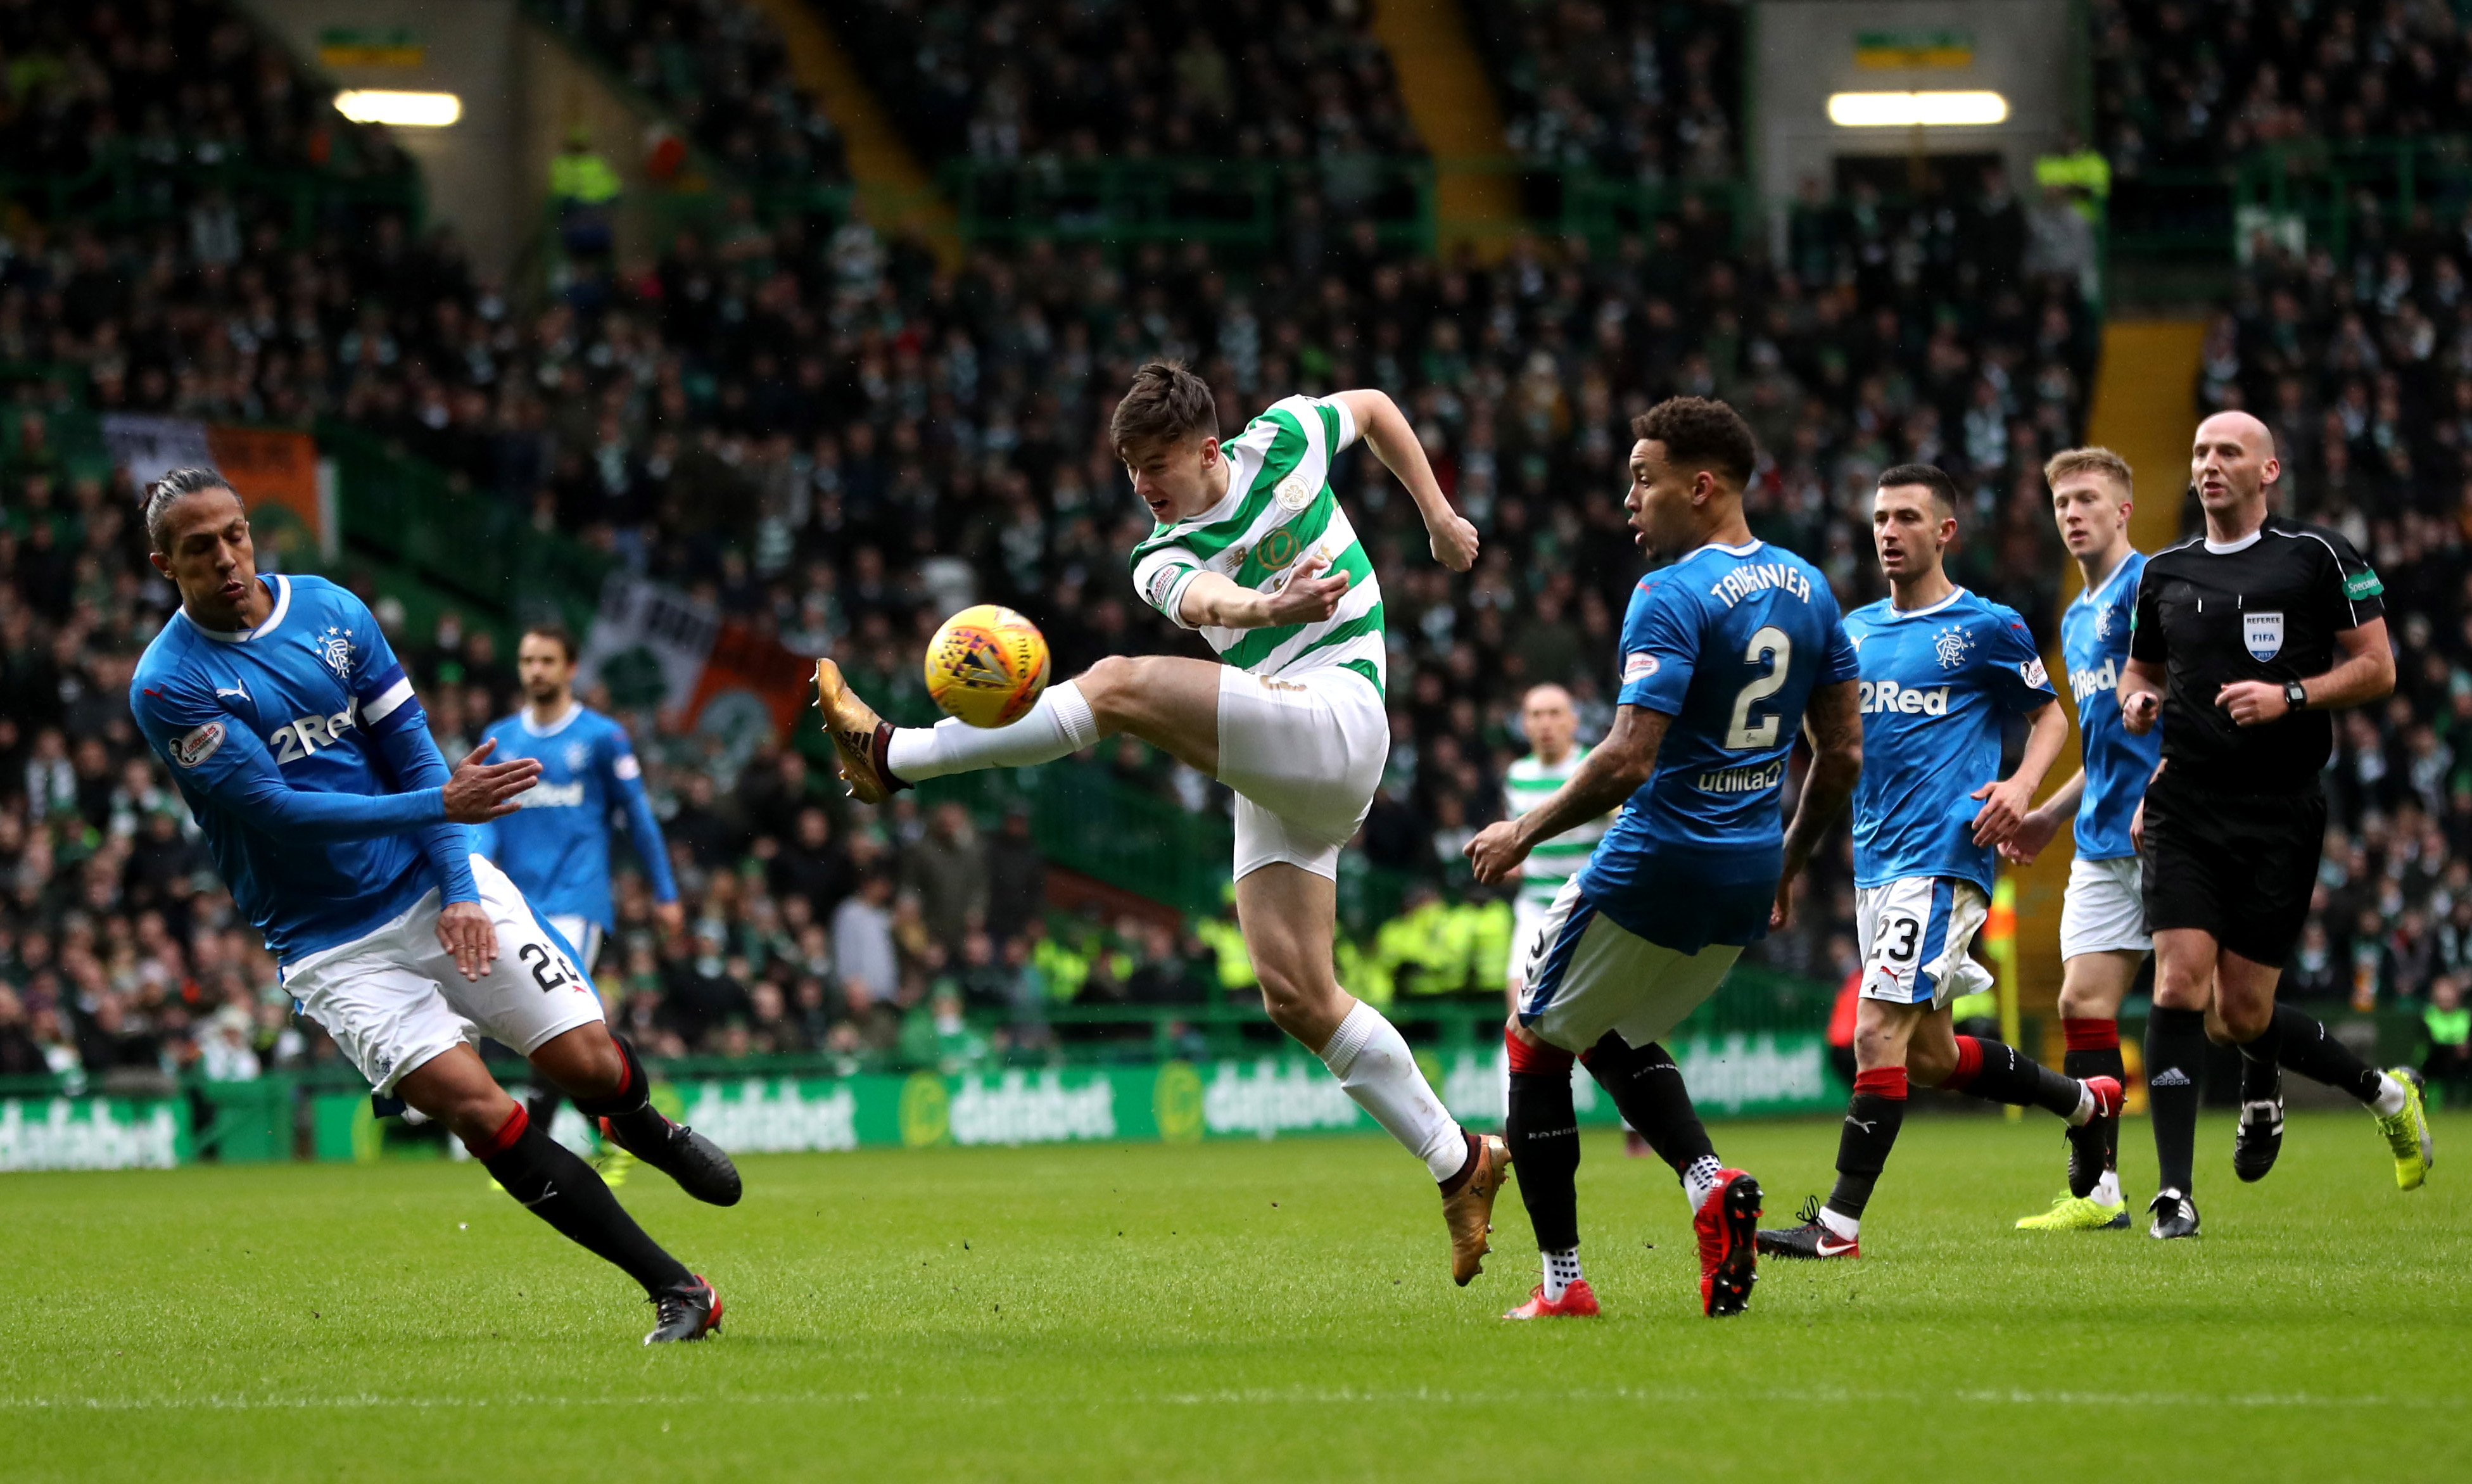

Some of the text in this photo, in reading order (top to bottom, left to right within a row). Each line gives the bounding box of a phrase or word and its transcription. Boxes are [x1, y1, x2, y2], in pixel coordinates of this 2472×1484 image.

[2253, 633, 2276, 643] FIFA
[1724, 625, 1792, 750] 2
[1859, 681, 1951, 716] 2Red
[184, 725, 217, 754] Ladbrokes
[835, 732, 869, 766] adidas
[1699, 767, 1765, 792] utilita
